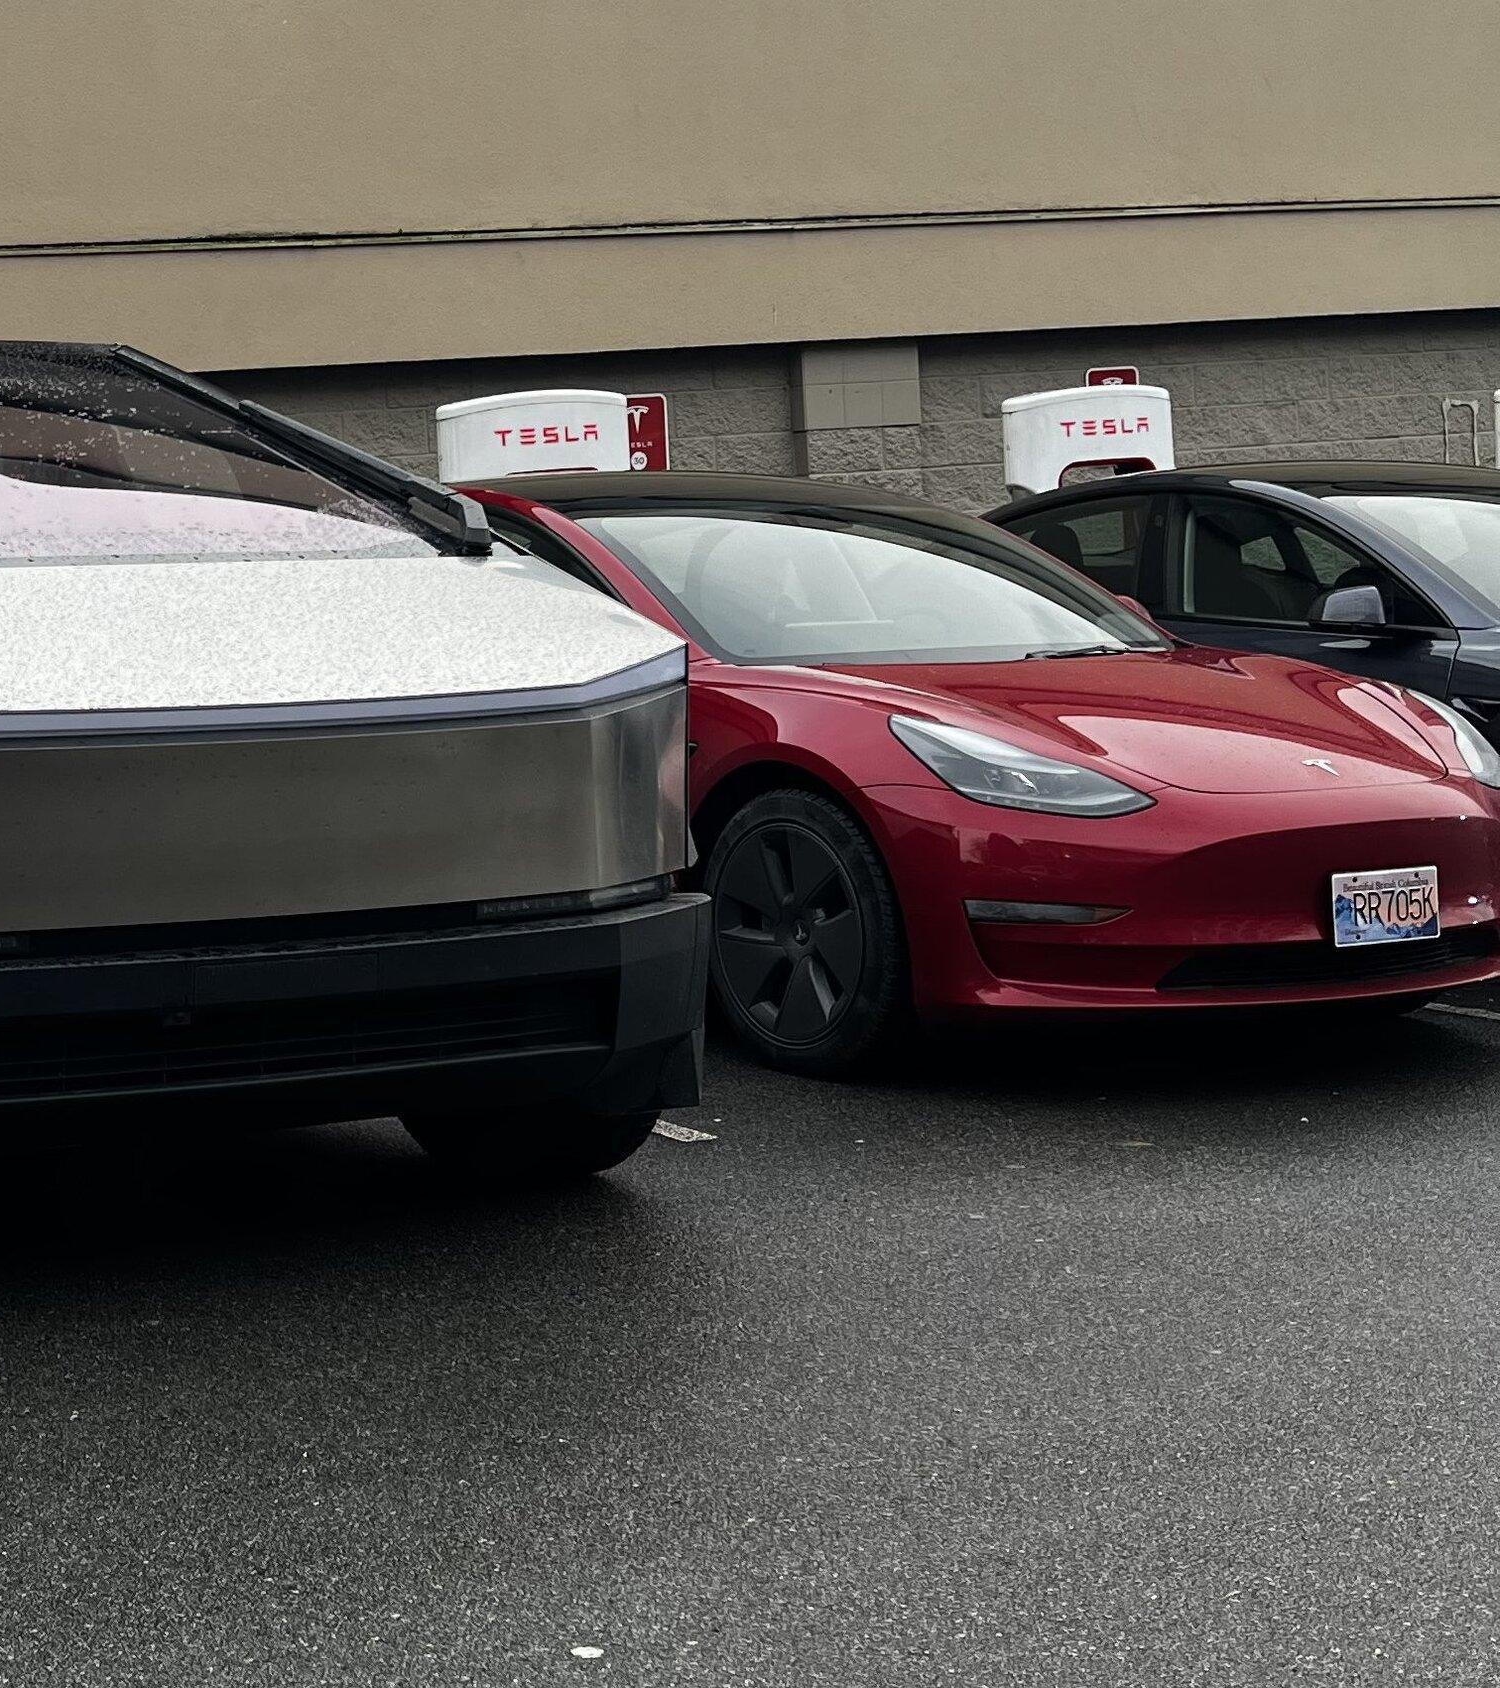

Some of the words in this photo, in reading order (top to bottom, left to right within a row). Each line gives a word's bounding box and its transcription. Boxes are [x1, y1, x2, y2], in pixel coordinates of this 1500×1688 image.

[493, 424, 599, 447] TESLA
[1059, 416, 1150, 438] TESLA
[630, 441, 653, 449] ESLA
